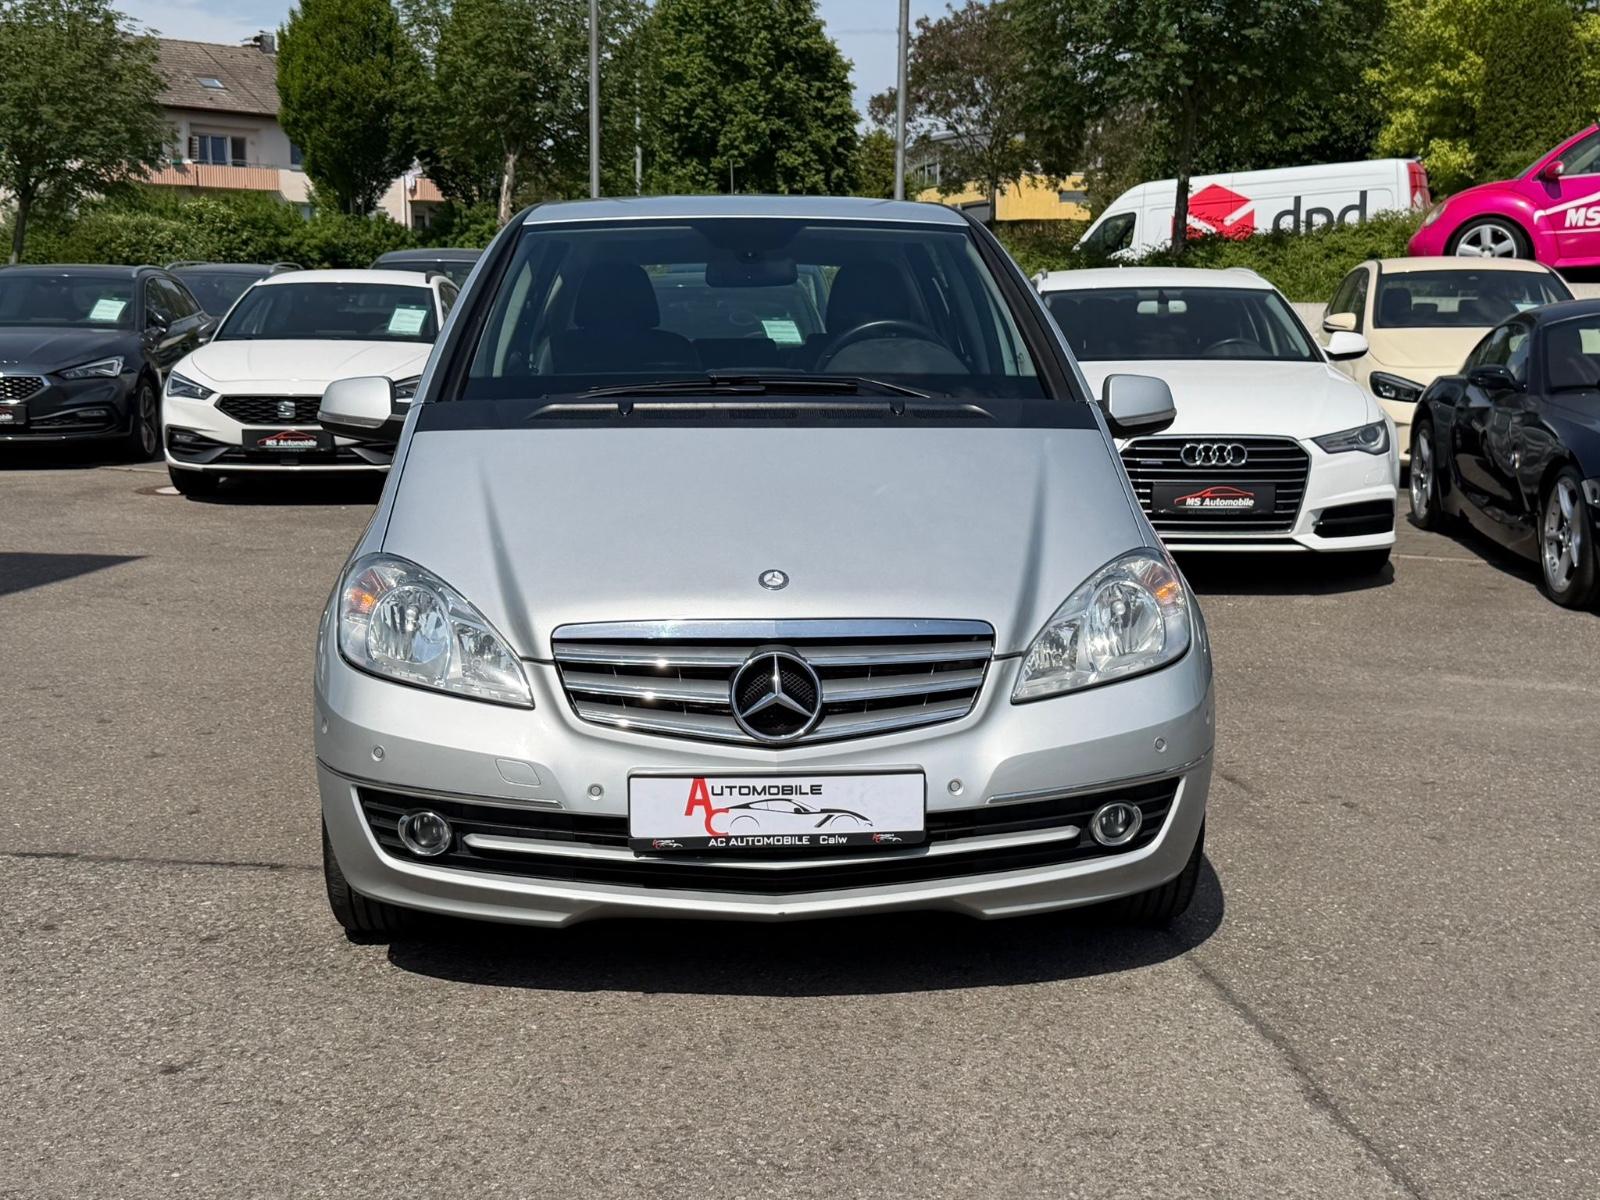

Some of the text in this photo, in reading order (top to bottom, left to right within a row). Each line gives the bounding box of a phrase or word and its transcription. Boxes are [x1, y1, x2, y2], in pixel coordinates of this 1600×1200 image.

[1272, 190, 1367, 234] dpd
[1564, 205, 1600, 228] MS
[1185, 497, 1255, 506] MS Automobile
[708, 834, 848, 847] AC AUTOMOBILE Calw
